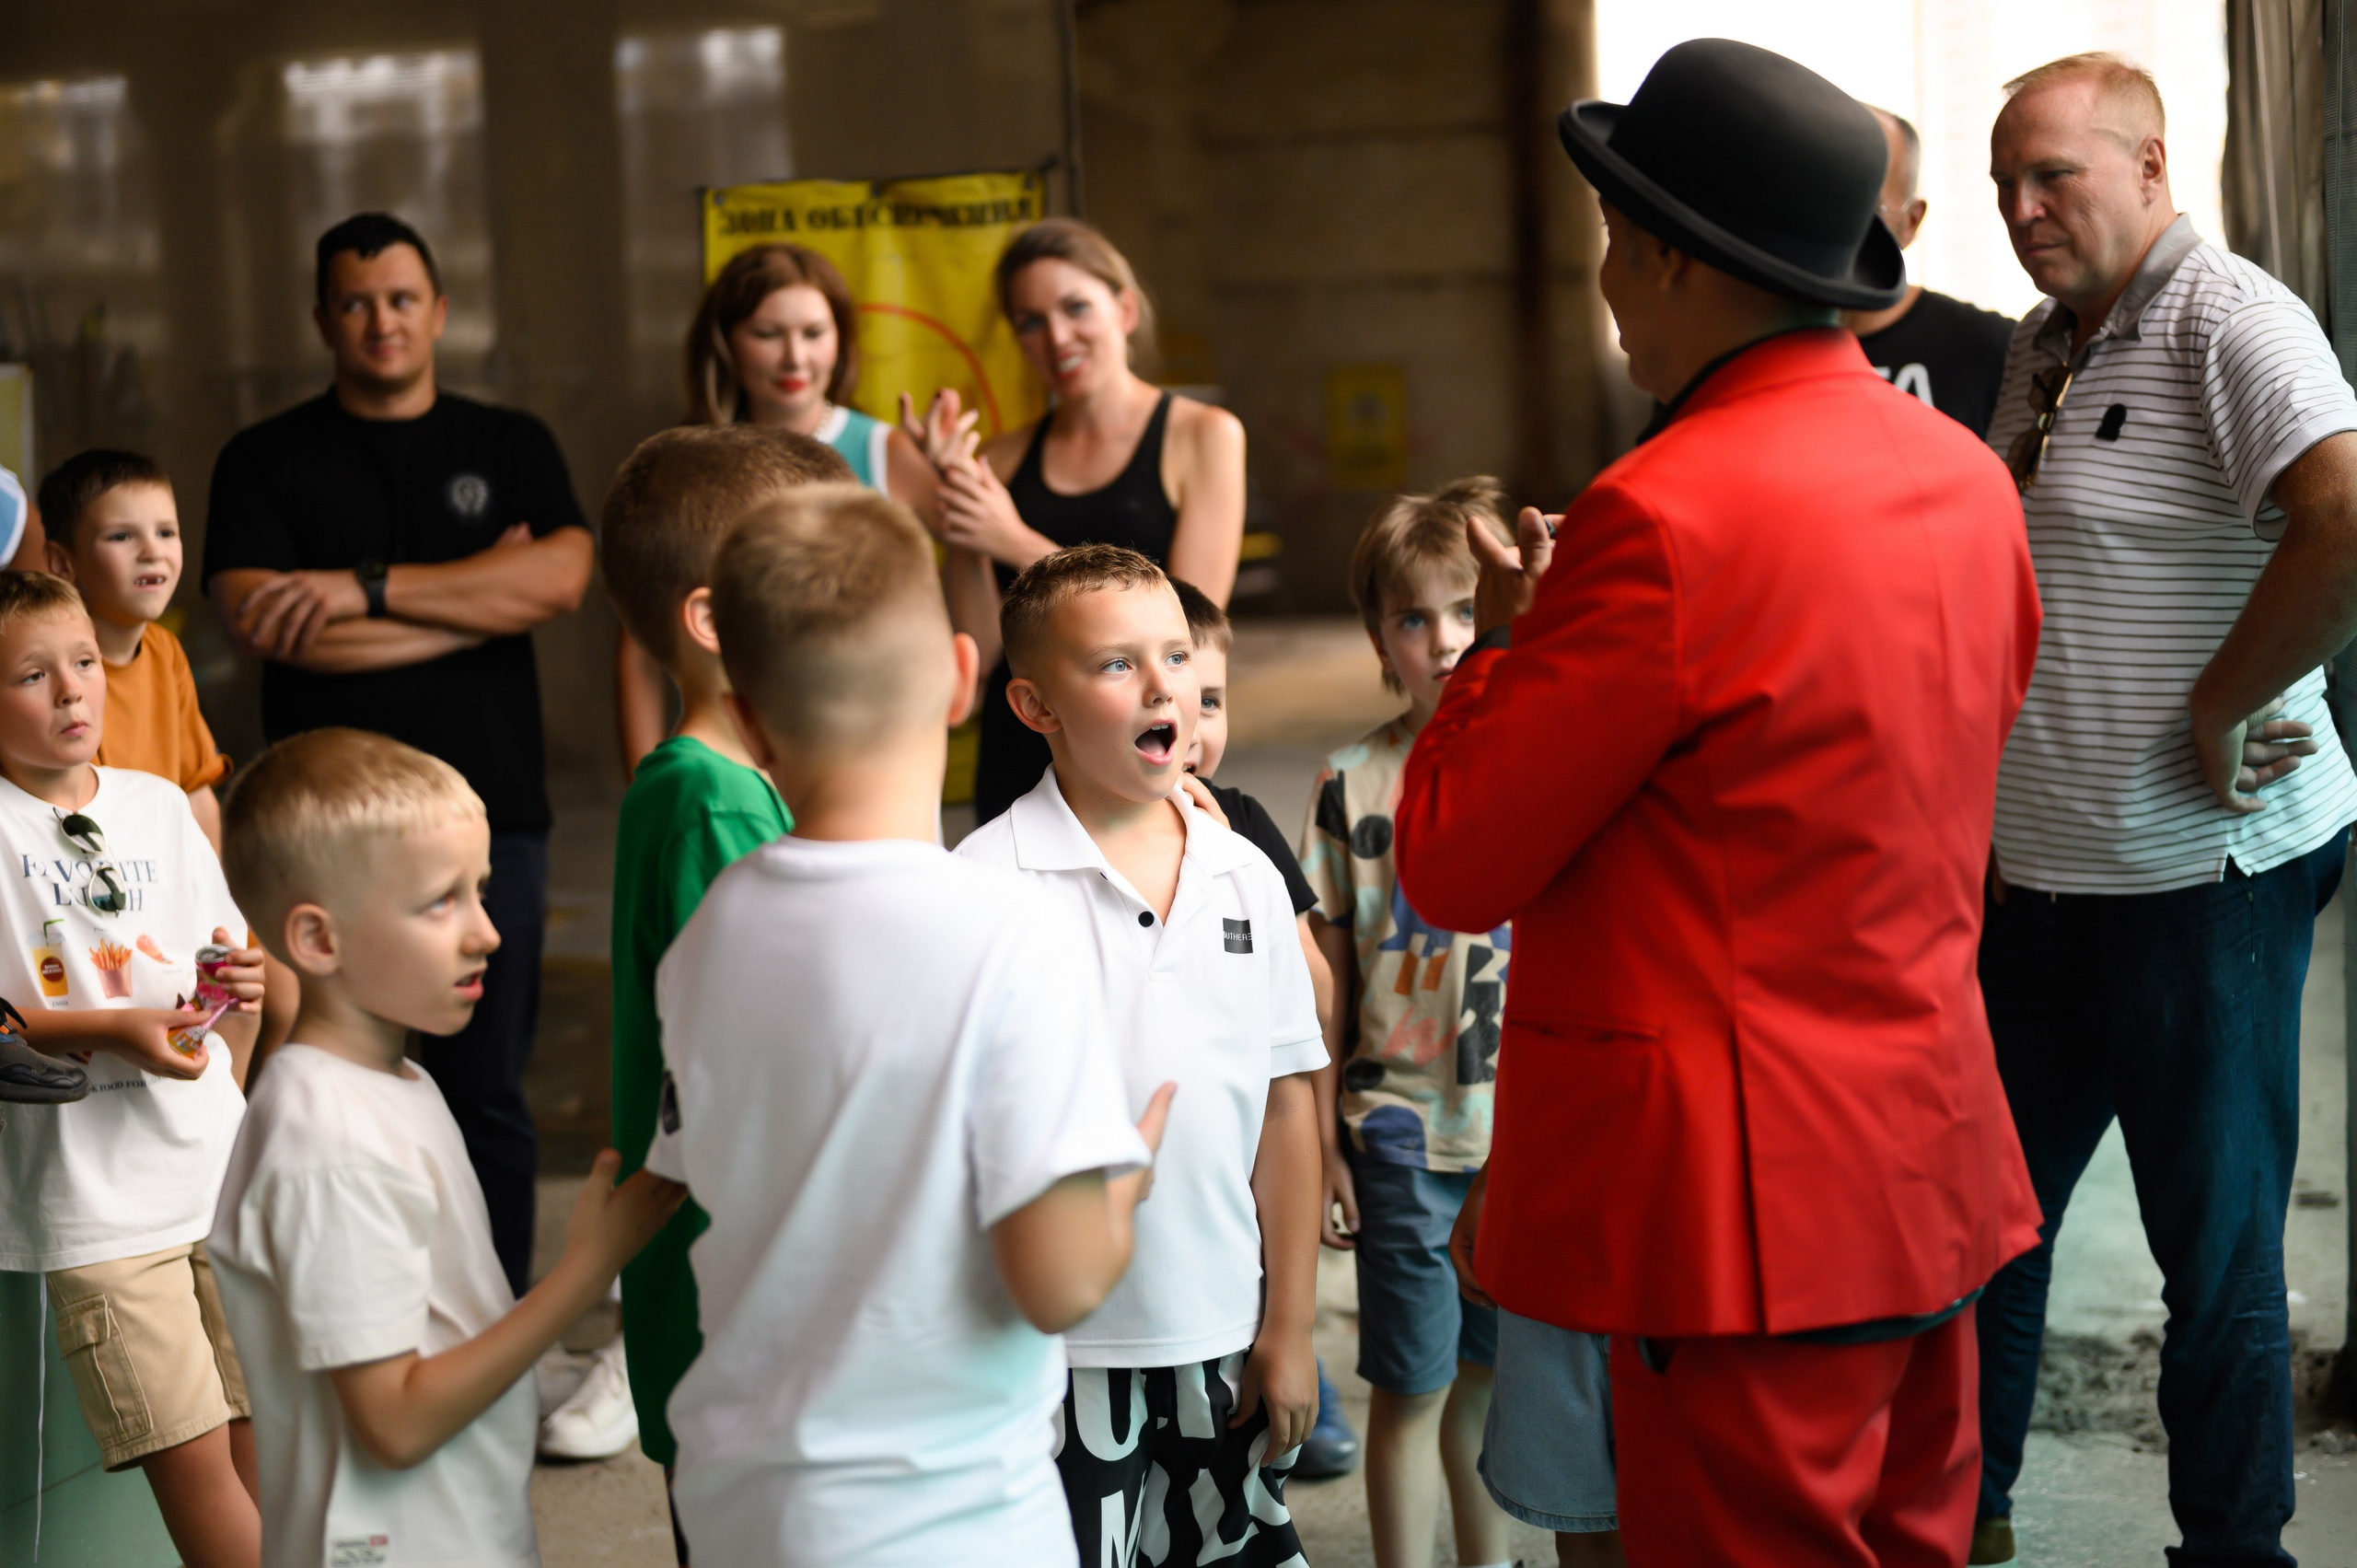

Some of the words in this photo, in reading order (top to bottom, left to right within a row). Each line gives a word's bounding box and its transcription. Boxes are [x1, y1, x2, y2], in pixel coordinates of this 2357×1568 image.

[20, 853, 158, 882] FVOITE
[52, 882, 143, 912] LUH
[99, 1081, 123, 1091] FOOD
